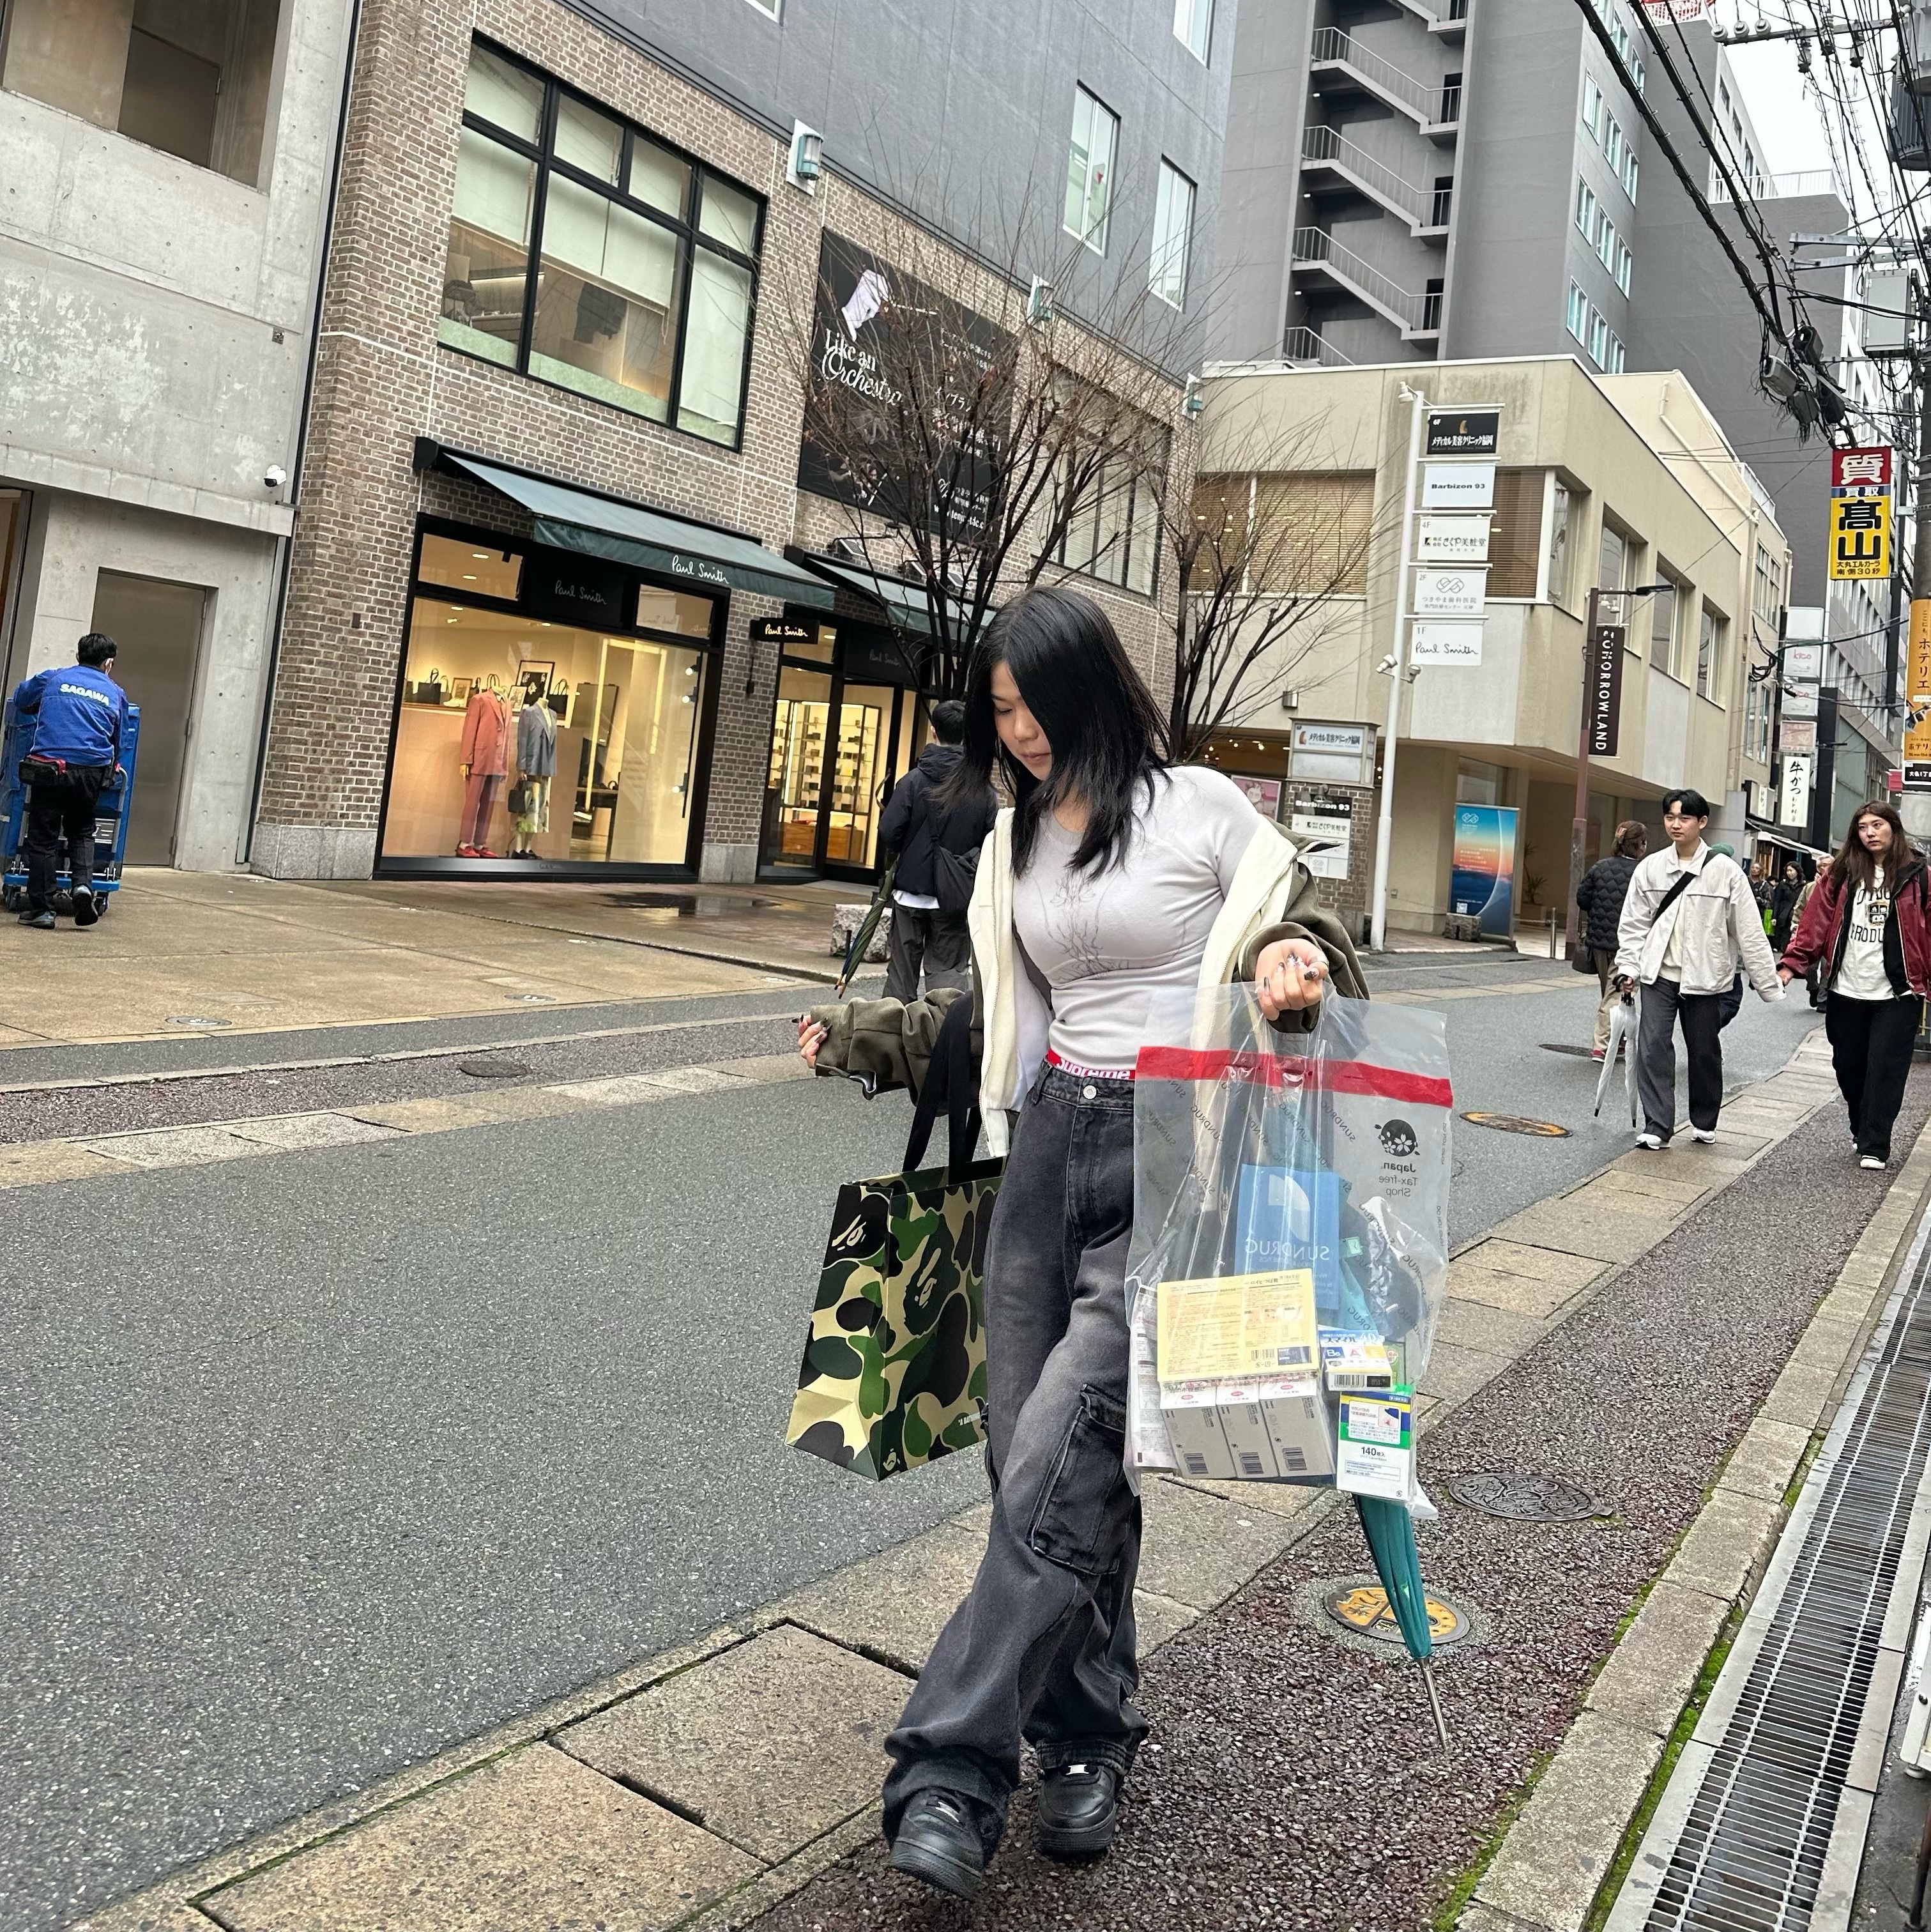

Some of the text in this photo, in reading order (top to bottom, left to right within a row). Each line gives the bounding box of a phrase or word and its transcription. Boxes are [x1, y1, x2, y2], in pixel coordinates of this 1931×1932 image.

[1840, 454, 1884, 486] 質
[1845, 487, 1879, 498] 買取
[672, 555, 729, 585] Paul Smith
[1836, 560, 1881, 569] 大丸エルガーラ
[555, 580, 607, 605] Paul Smith
[765, 624, 808, 638] Paul Smith
[1416, 641, 1479, 655] Paul Smith
[1917, 638, 1930, 689] ホテリエ
[60, 684, 109, 706] SAGAWA
[1789, 761, 1804, 795] 牛かつ
